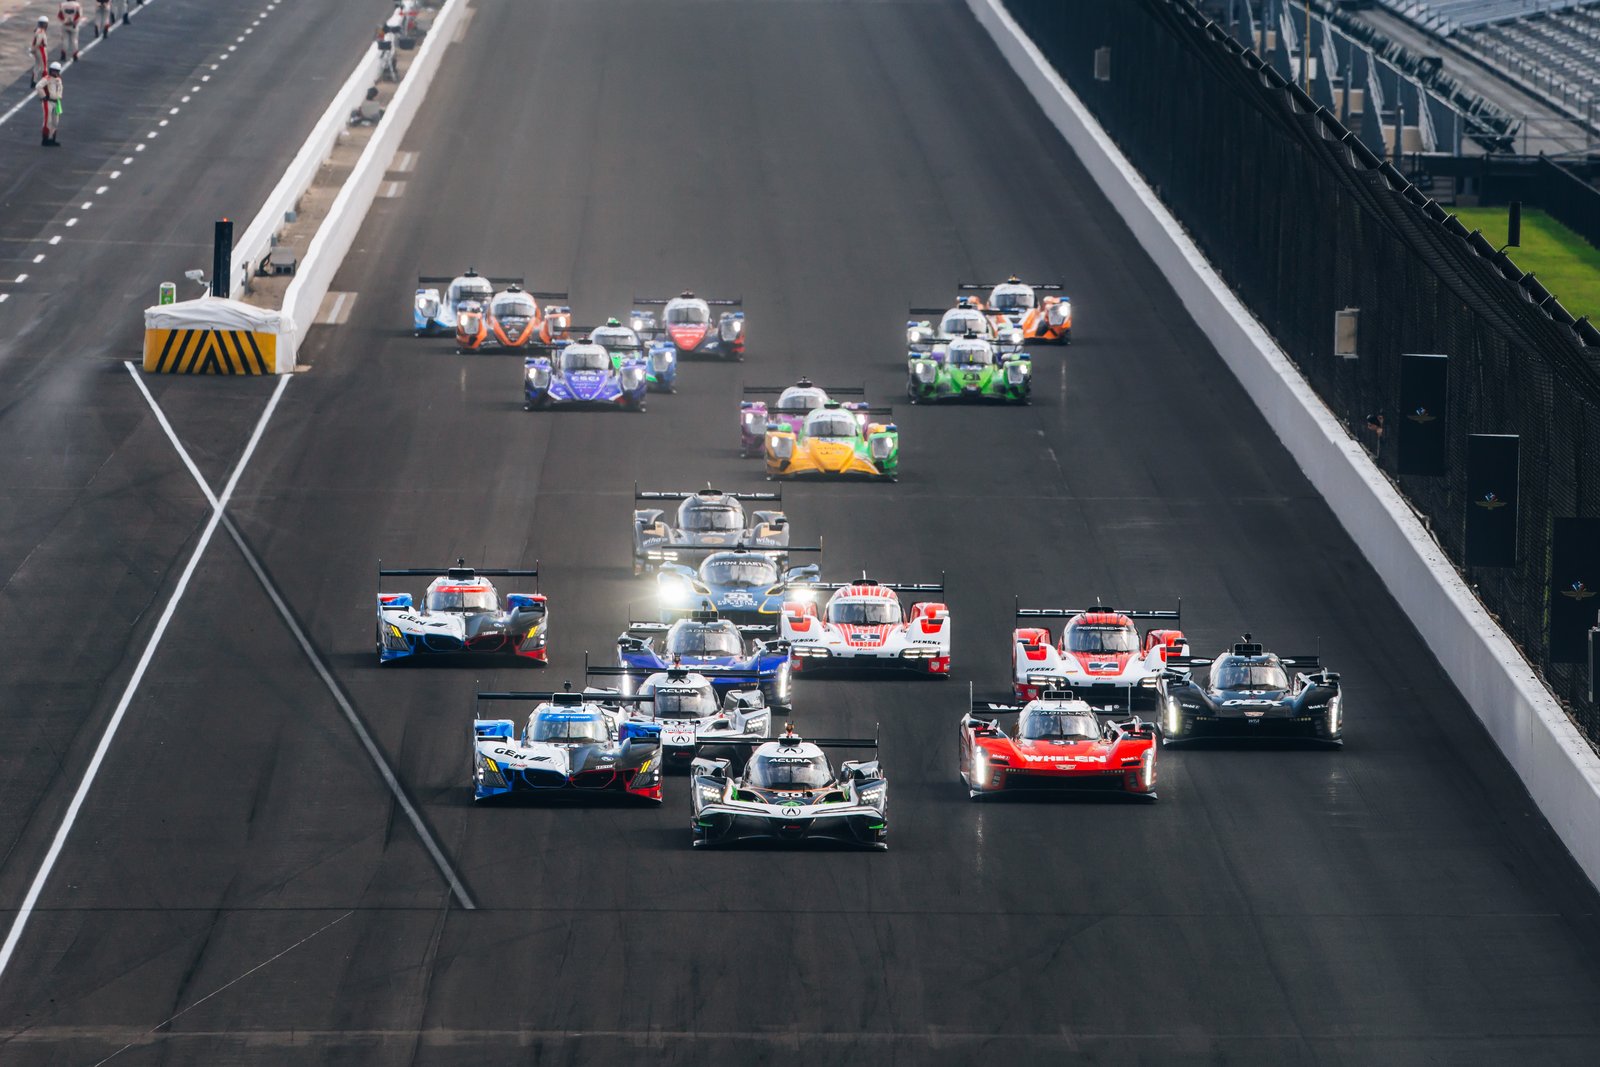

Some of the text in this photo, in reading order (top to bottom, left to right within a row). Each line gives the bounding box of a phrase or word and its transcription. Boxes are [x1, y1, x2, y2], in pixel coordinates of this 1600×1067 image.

[398, 614, 427, 626] GEN
[1030, 709, 1089, 717] CADILLAC
[493, 746, 527, 760] GEN
[1022, 753, 1108, 763] WHELEN
